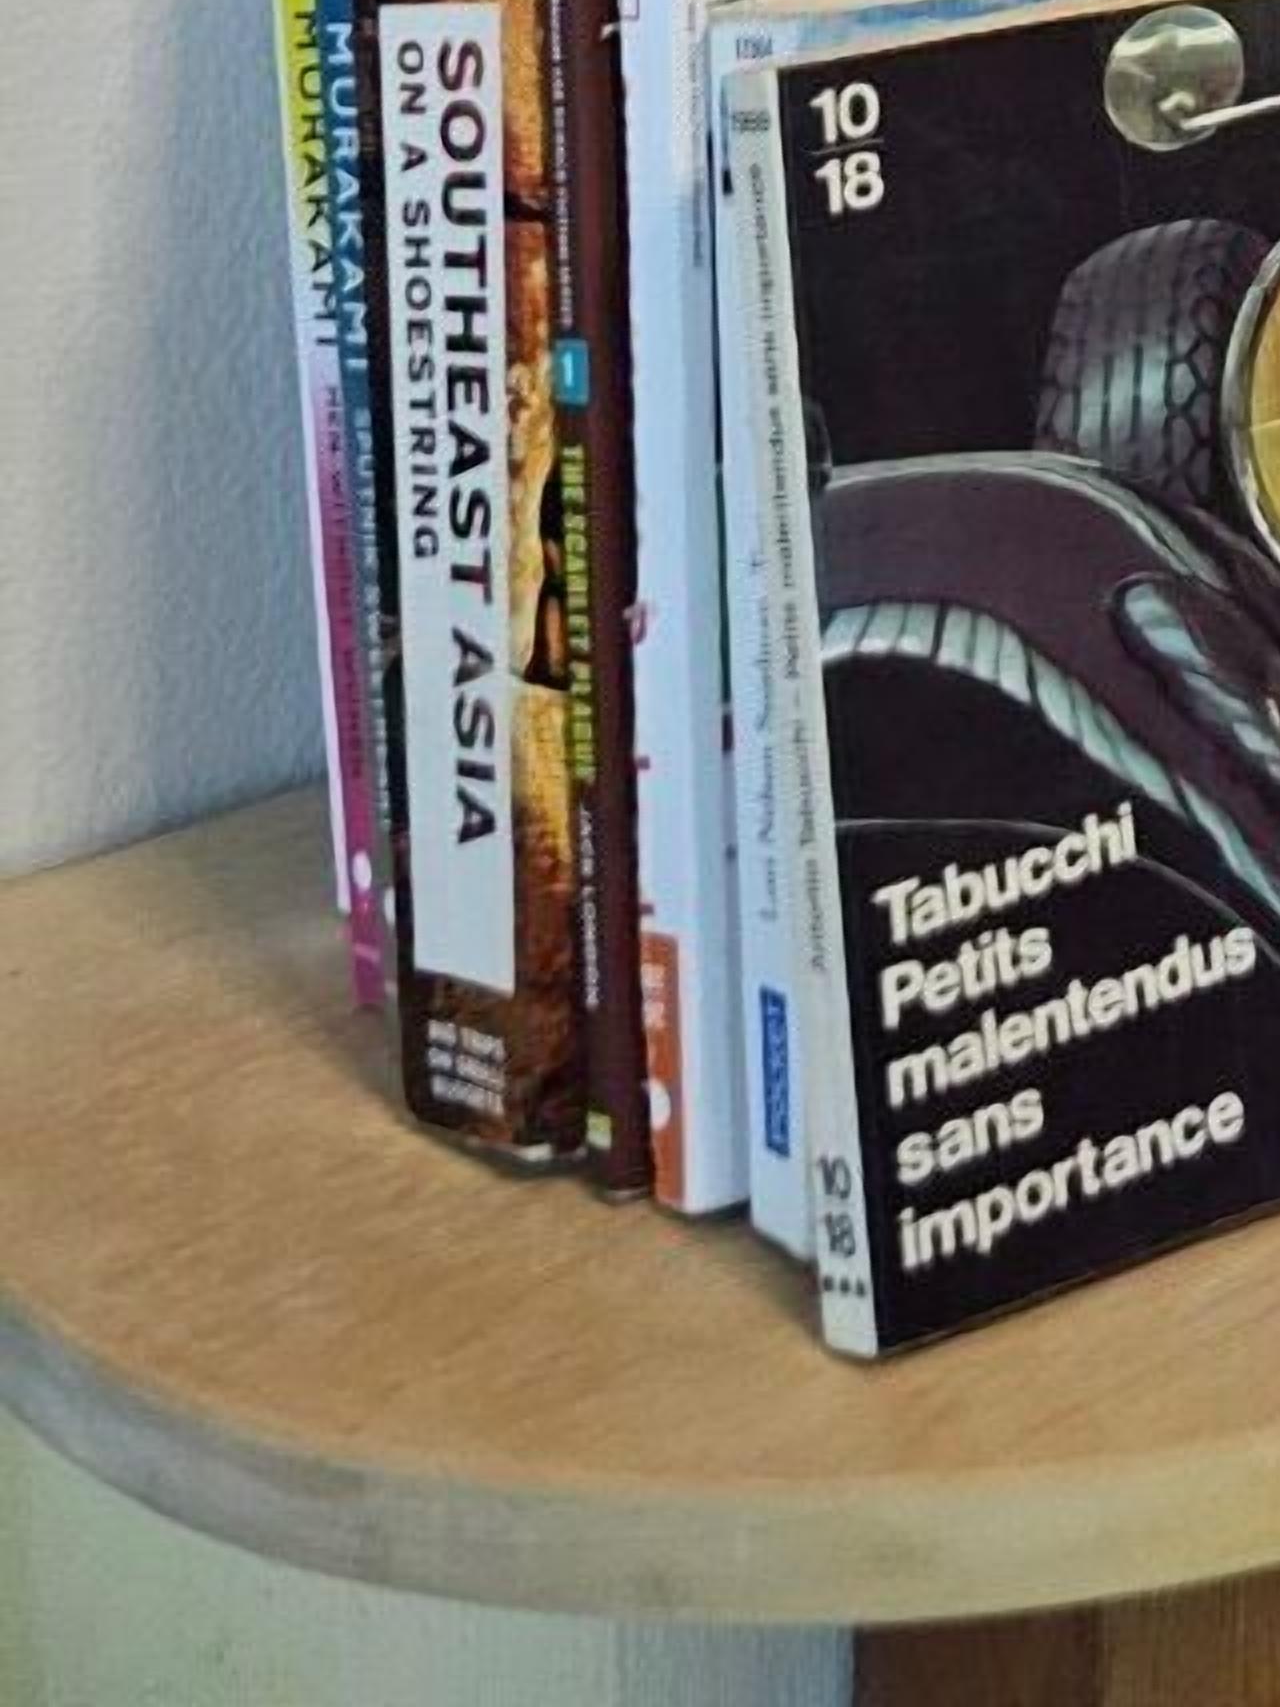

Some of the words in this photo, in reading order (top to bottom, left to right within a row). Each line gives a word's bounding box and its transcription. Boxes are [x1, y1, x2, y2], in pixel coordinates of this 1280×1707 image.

[398, 39, 424, 117] ON
[810, 81, 880, 143] 10
[295, 11, 338, 348] MURAKAMI
[325, 22, 370, 373] MURAKAMI
[401, 148, 428, 175] A
[814, 152, 885, 215] 18
[401, 199, 439, 560] SHOESTRING
[436, 39, 494, 604] SOUTHEAST
[561, 444, 585, 501] THE
[564, 513, 591, 652] SCARLET
[450, 627, 500, 847] ASIA
[872, 803, 1138, 945] Tabucchi
[582, 886, 599, 1010] LONDON
[880, 923, 1054, 1029] Petits
[886, 927, 1258, 1109] malentendus
[896, 1089, 1044, 1187] sans
[900, 1091, 1246, 1273] importance
